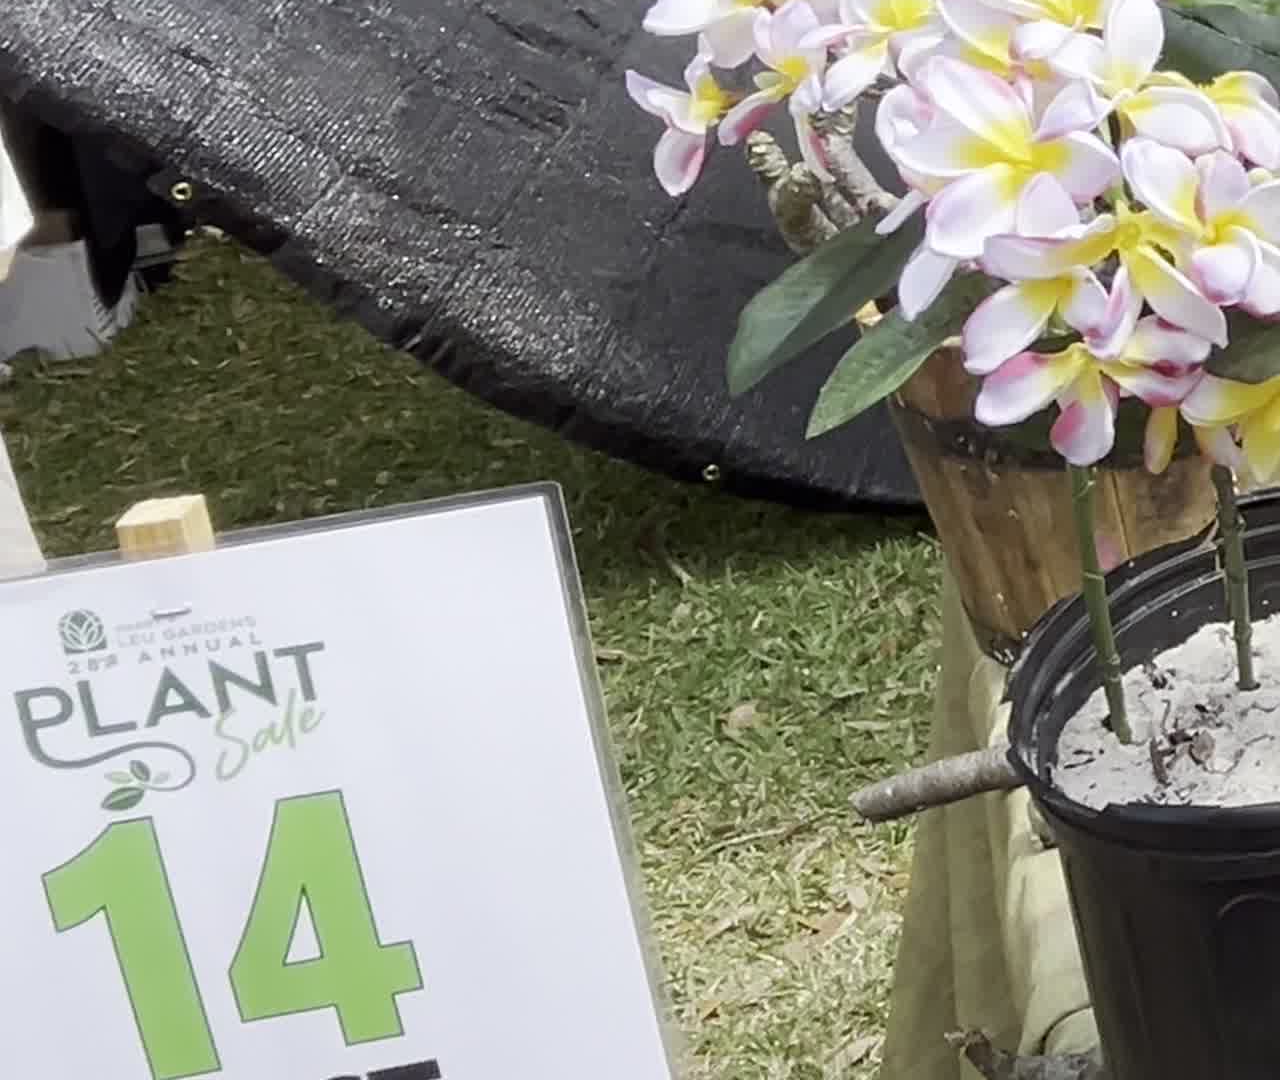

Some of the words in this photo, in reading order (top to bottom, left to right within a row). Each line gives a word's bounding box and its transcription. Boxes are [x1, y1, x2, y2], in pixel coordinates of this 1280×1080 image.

[14, 640, 325, 767] PLANT
[137, 631, 263, 665] ANNUAL
[215, 686, 326, 781] Sale
[42, 788, 424, 1080] 14
